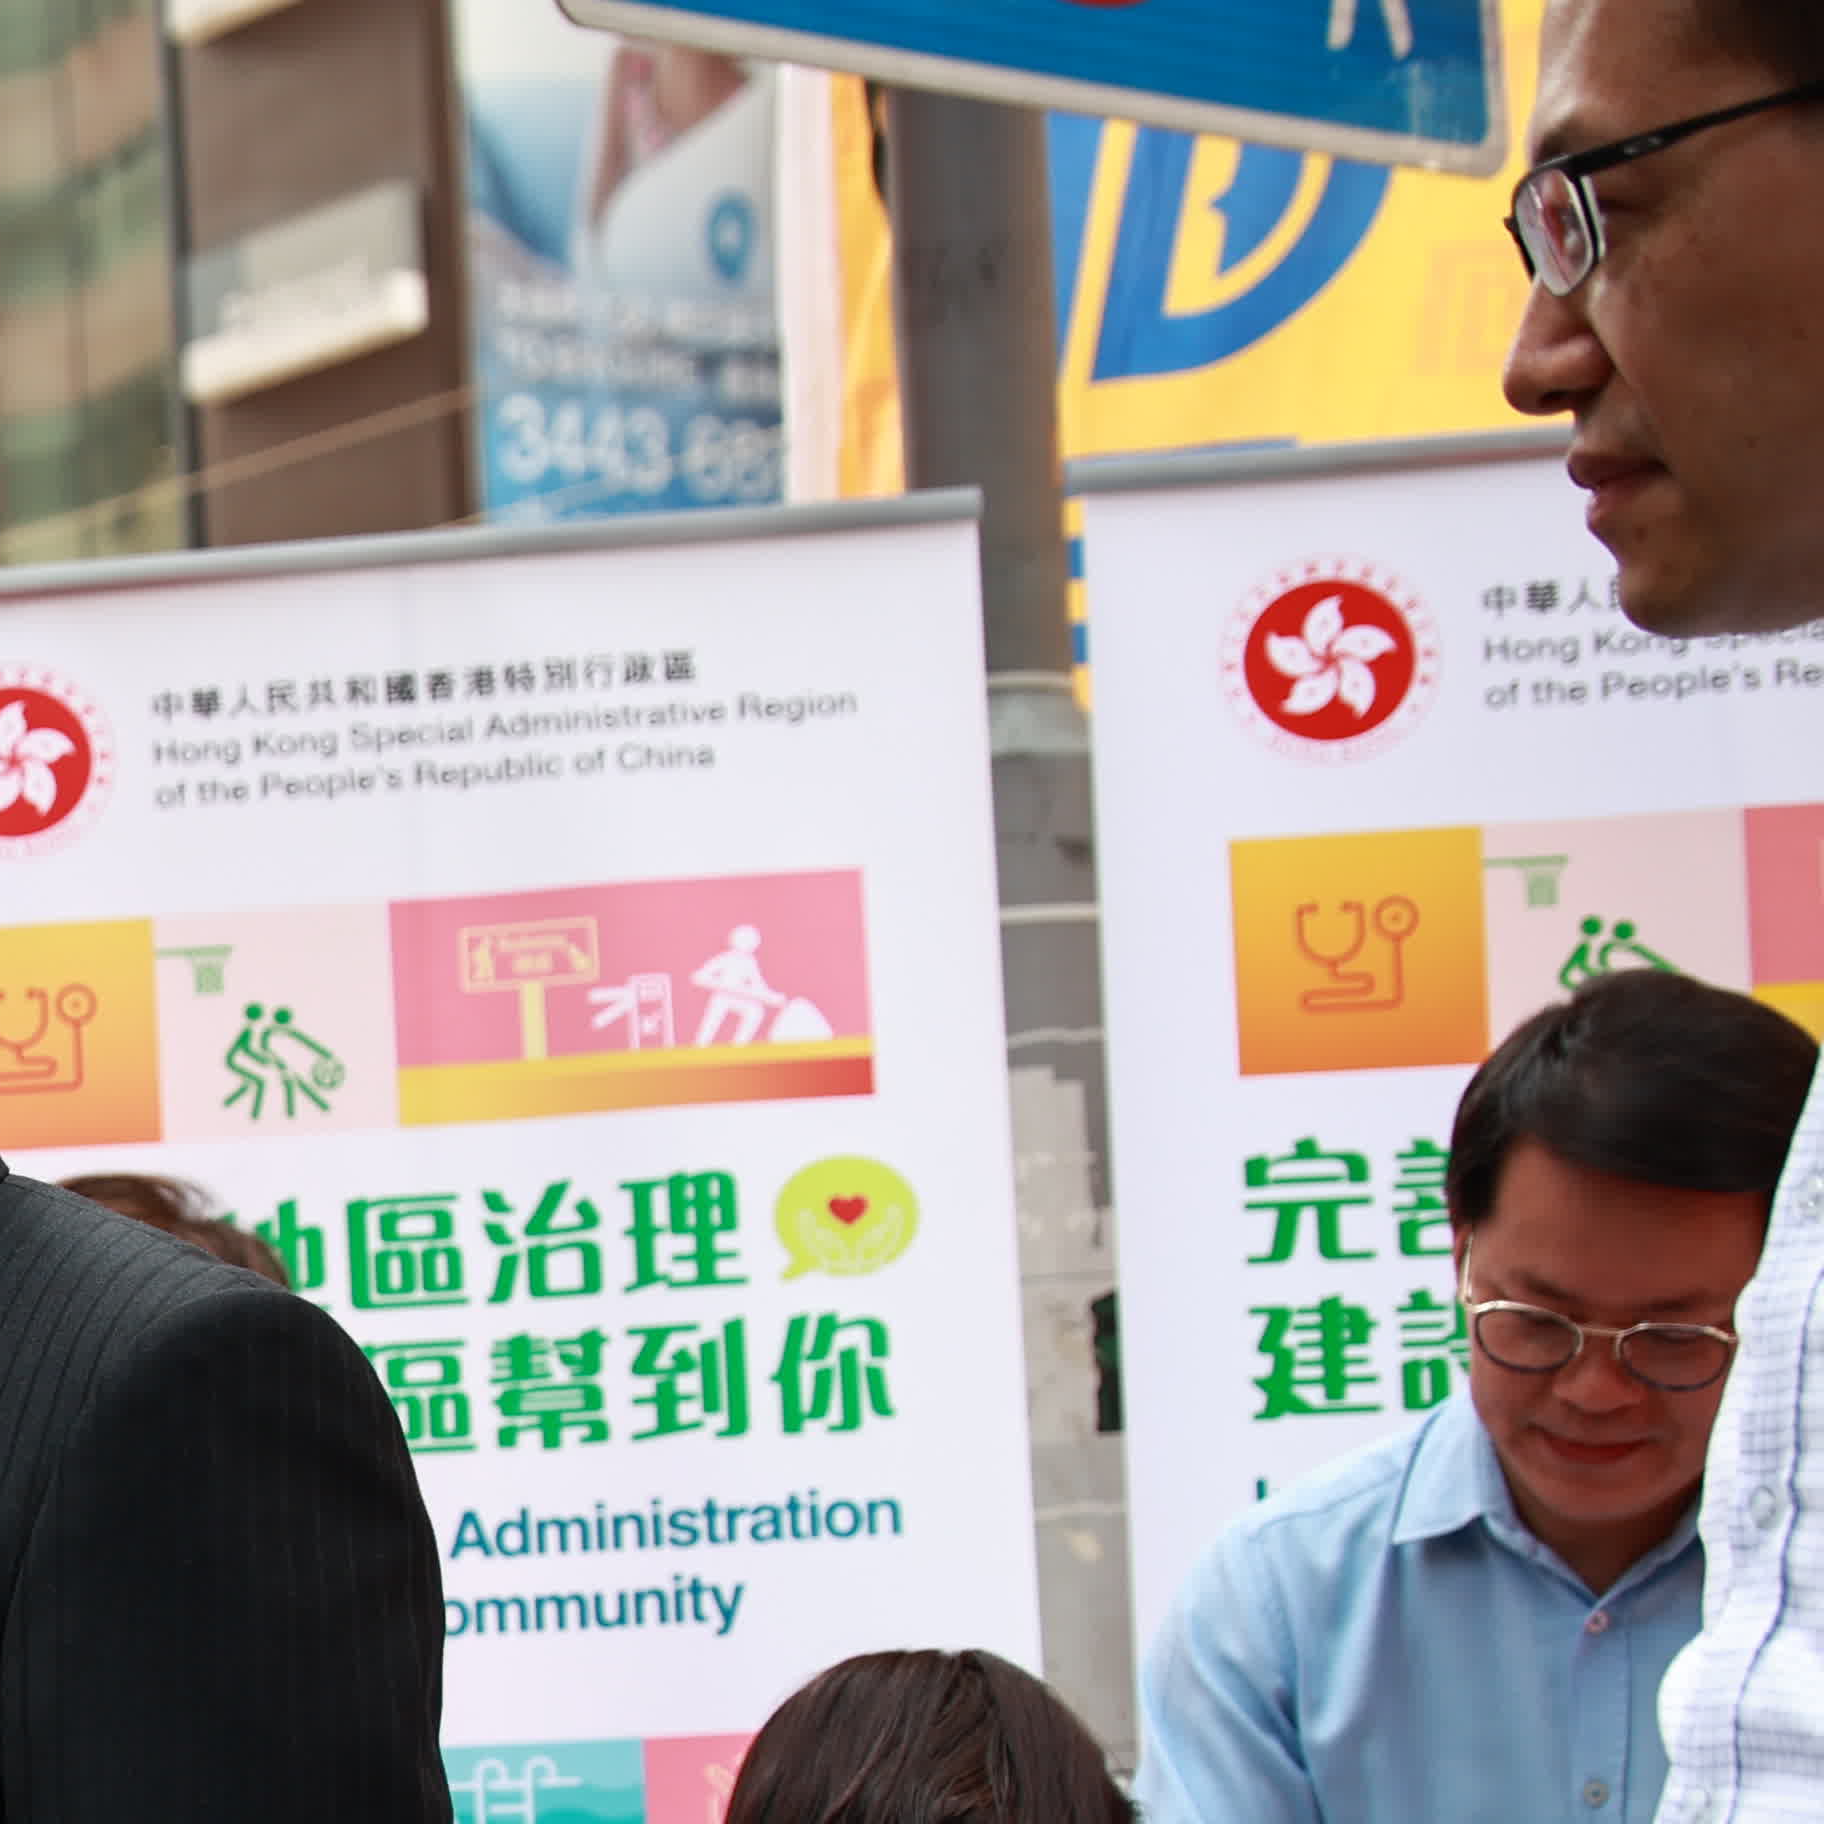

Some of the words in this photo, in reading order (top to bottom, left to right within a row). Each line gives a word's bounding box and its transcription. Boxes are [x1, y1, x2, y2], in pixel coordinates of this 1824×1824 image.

[1484, 633, 1580, 665] Hong
[151, 650, 697, 720] 中華人民共和國香港特別行政區
[1485, 676, 1519, 707] of
[1532, 679, 1589, 704] the
[1601, 662, 1761, 700] People's
[155, 737, 242, 766] Hong
[254, 728, 339, 759] Kong
[350, 715, 473, 753] Special
[486, 699, 728, 738] Administrative
[738, 690, 859, 723] Region
[156, 779, 186, 808] of
[198, 780, 249, 803] the
[260, 765, 403, 800] People's
[414, 753, 563, 789] Republic
[574, 748, 606, 774] of
[616, 742, 716, 772] China
[450, 1489, 904, 1559] Administration
[444, 1572, 747, 1636] ommunity
